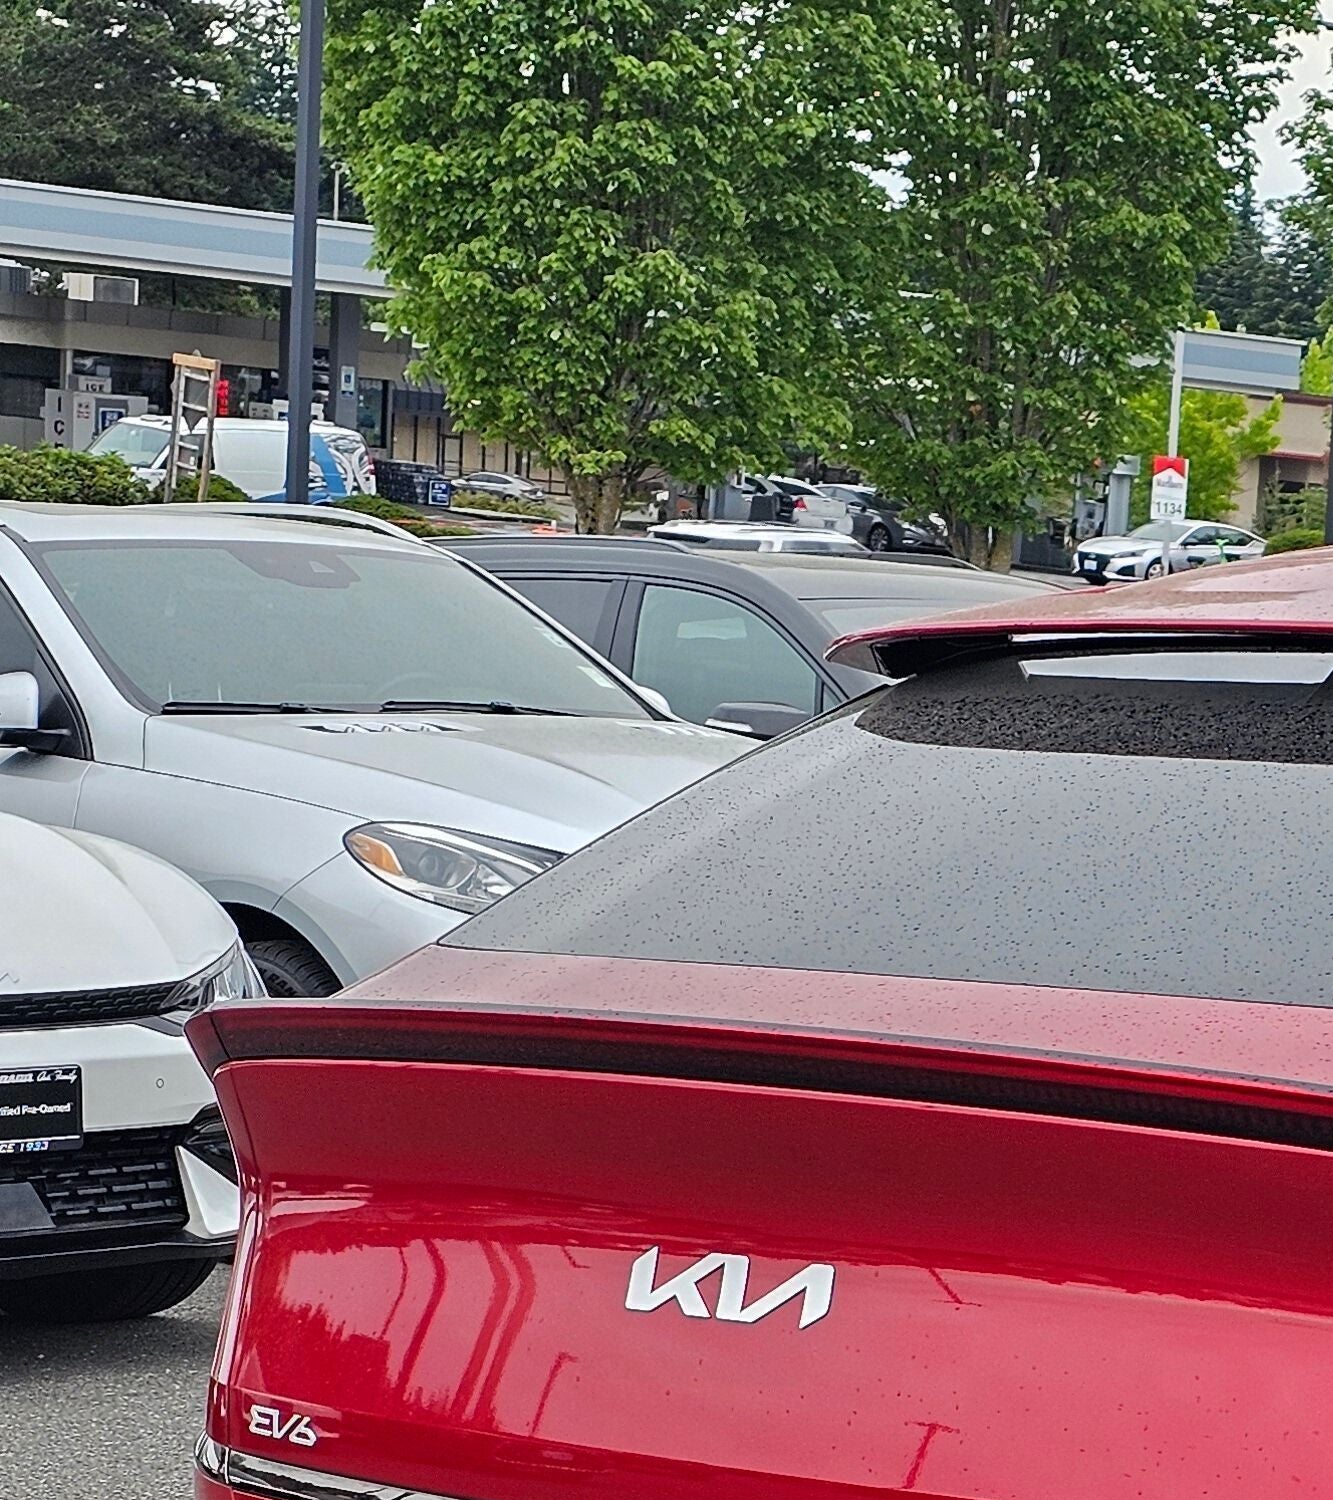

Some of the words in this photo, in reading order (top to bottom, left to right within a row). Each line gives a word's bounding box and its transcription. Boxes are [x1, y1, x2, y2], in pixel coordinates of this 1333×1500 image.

[1156, 501, 1183, 515] 1134
[625, 1246, 836, 1330] KIA
[249, 1404, 317, 1447] EV6
